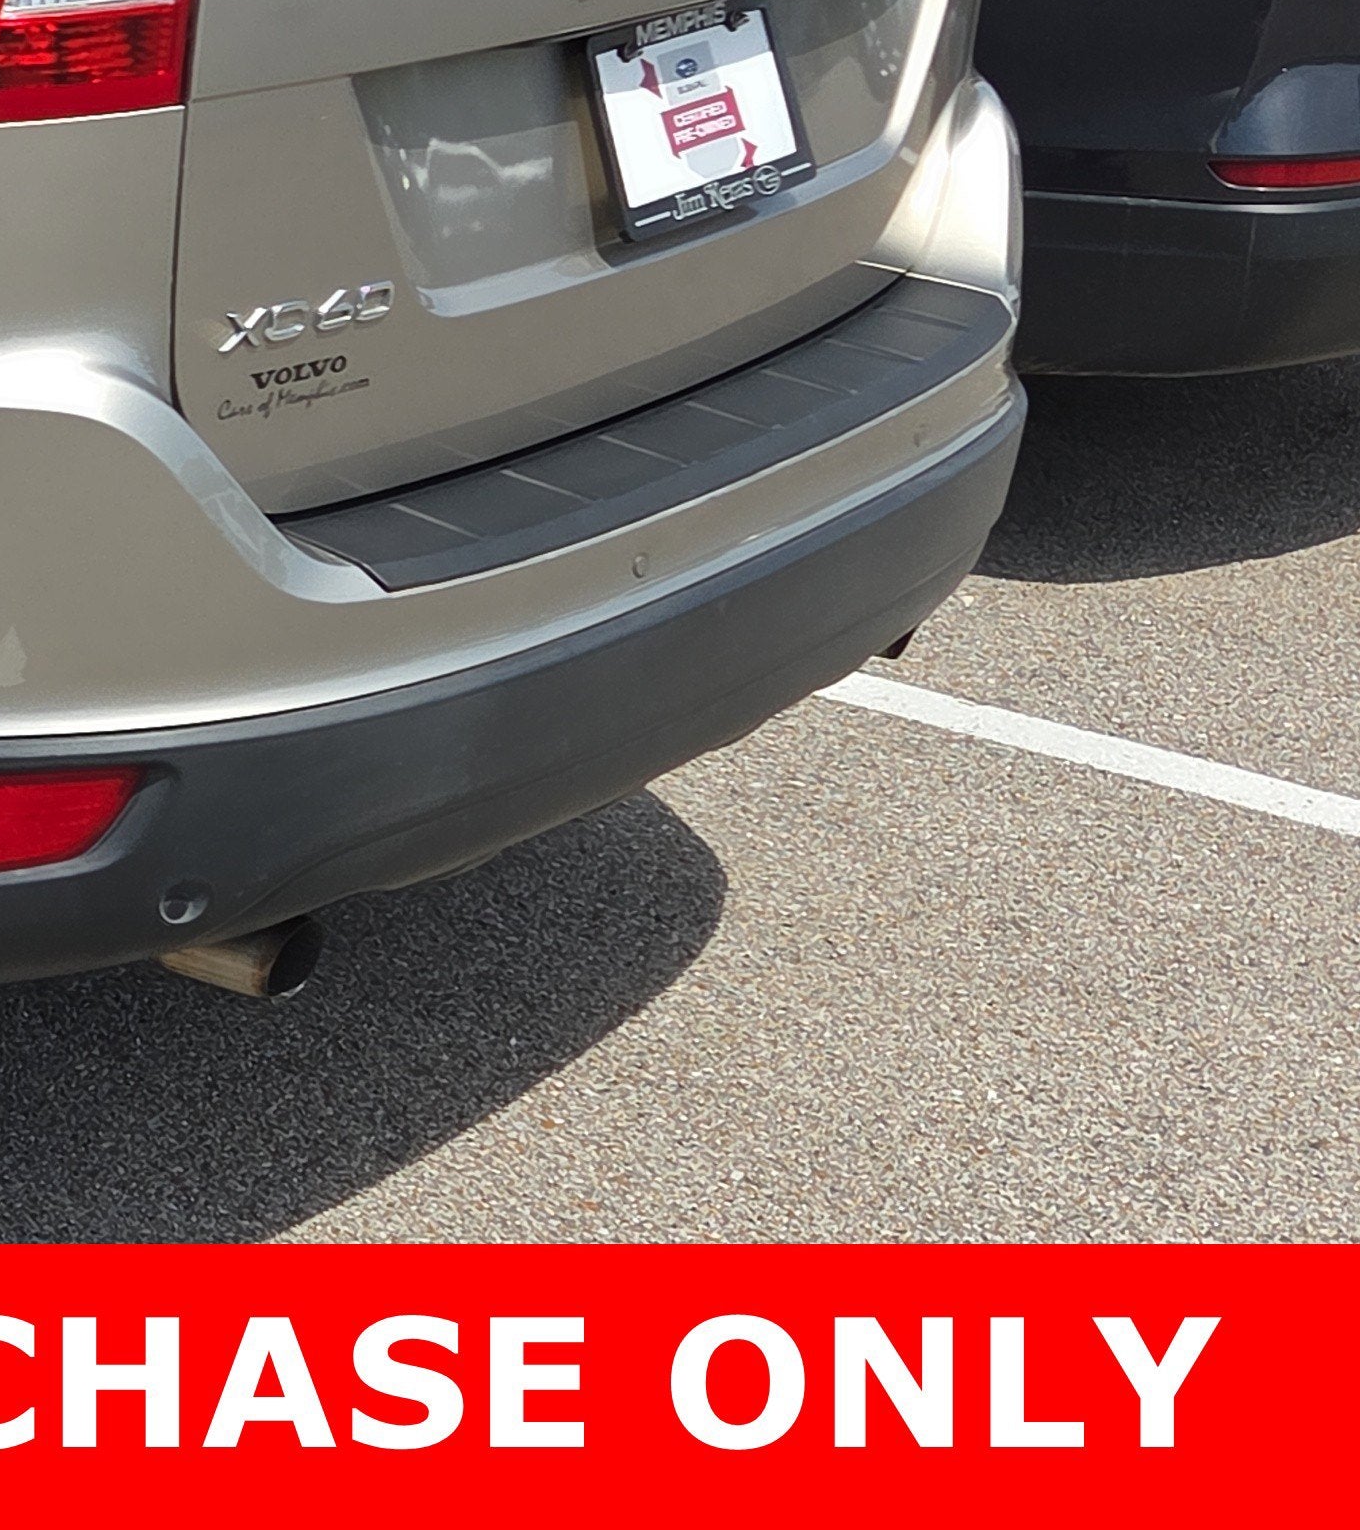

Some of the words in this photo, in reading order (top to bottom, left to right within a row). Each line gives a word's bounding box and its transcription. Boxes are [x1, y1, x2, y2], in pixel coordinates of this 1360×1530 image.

[635, 1, 726, 46] MEMPHIS
[673, 193, 708, 220] Jim
[217, 280, 395, 353] XC60
[249, 355, 347, 390] VOLVO
